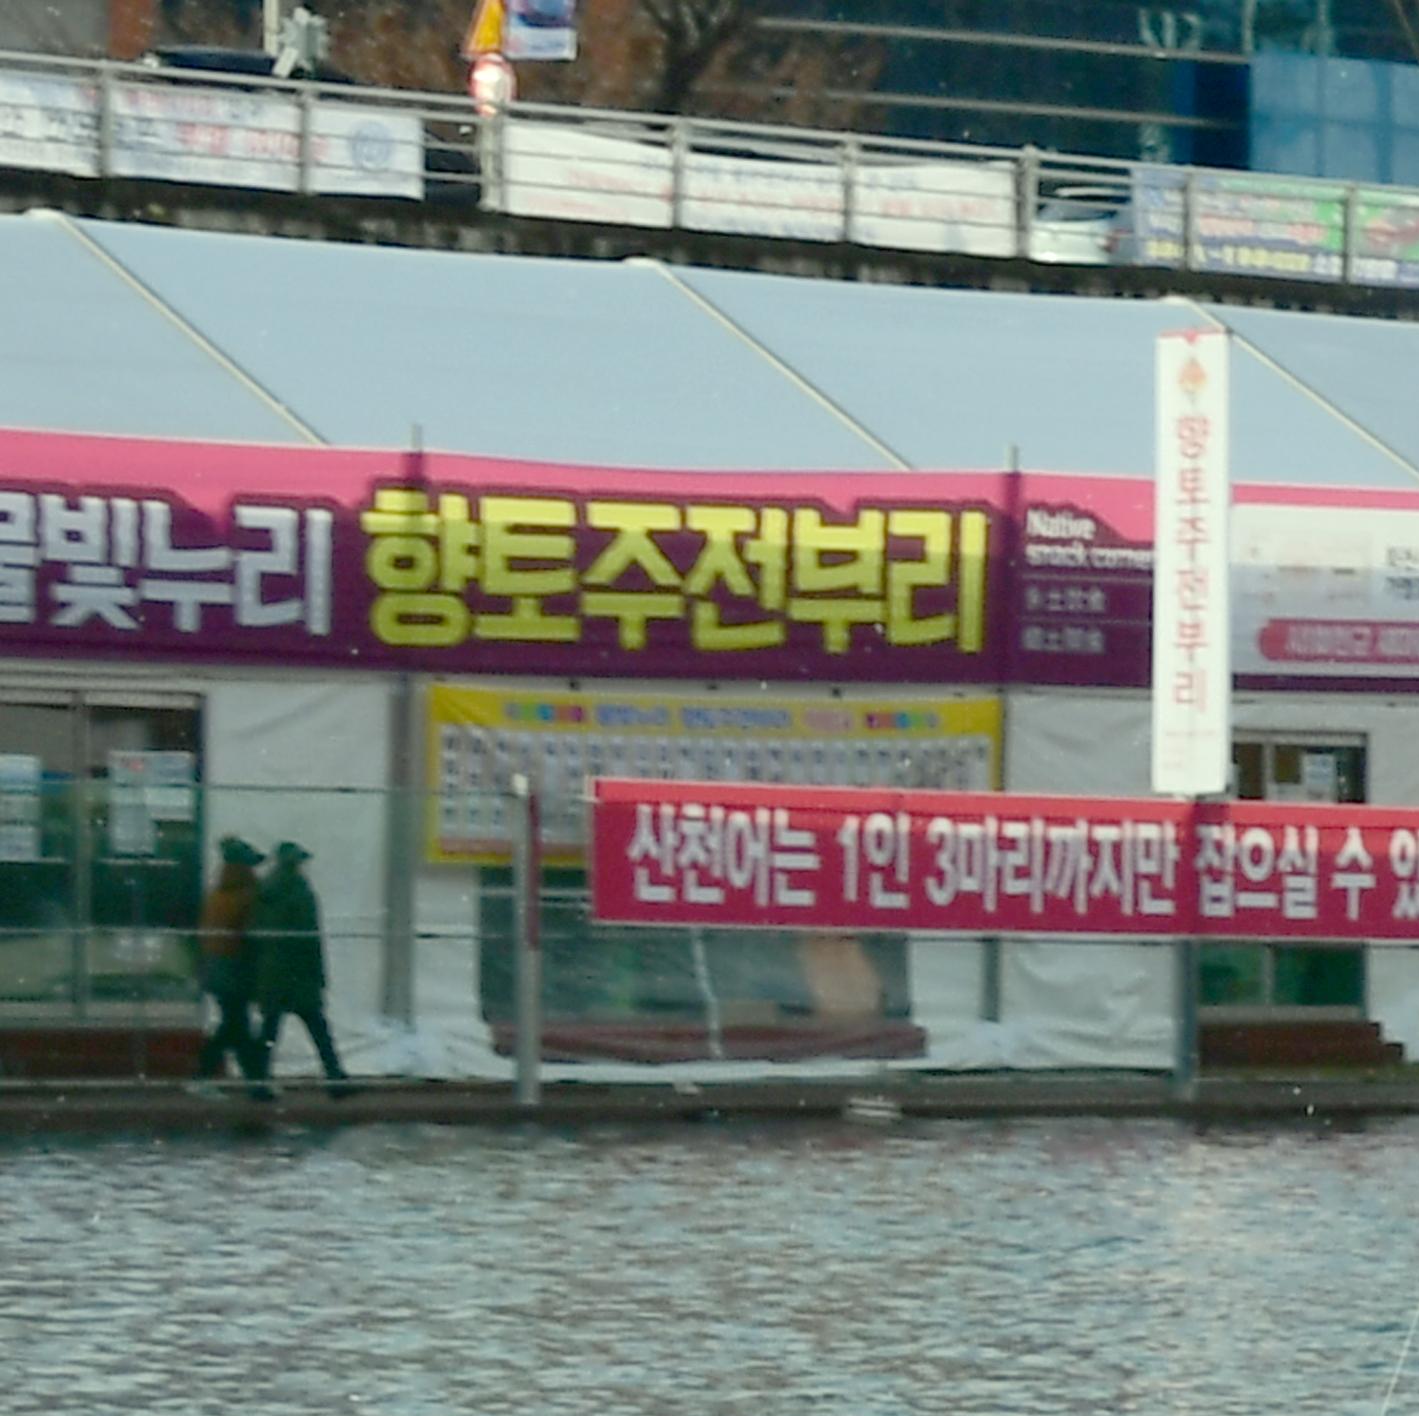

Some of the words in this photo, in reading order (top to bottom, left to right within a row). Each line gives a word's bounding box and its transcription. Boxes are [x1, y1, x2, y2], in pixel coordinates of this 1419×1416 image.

[1025, 540, 1085, 568] snack
[1027, 507, 1097, 541] Native
[361, 487, 988, 654] 향토주전부리
[627, 803, 823, 908] 산천어는
[837, 811, 911, 911] 1인
[925, 815, 1180, 917] 3마리까지만
[1195, 821, 1319, 921] 잡으실
[1331, 825, 1377, 922] 수
